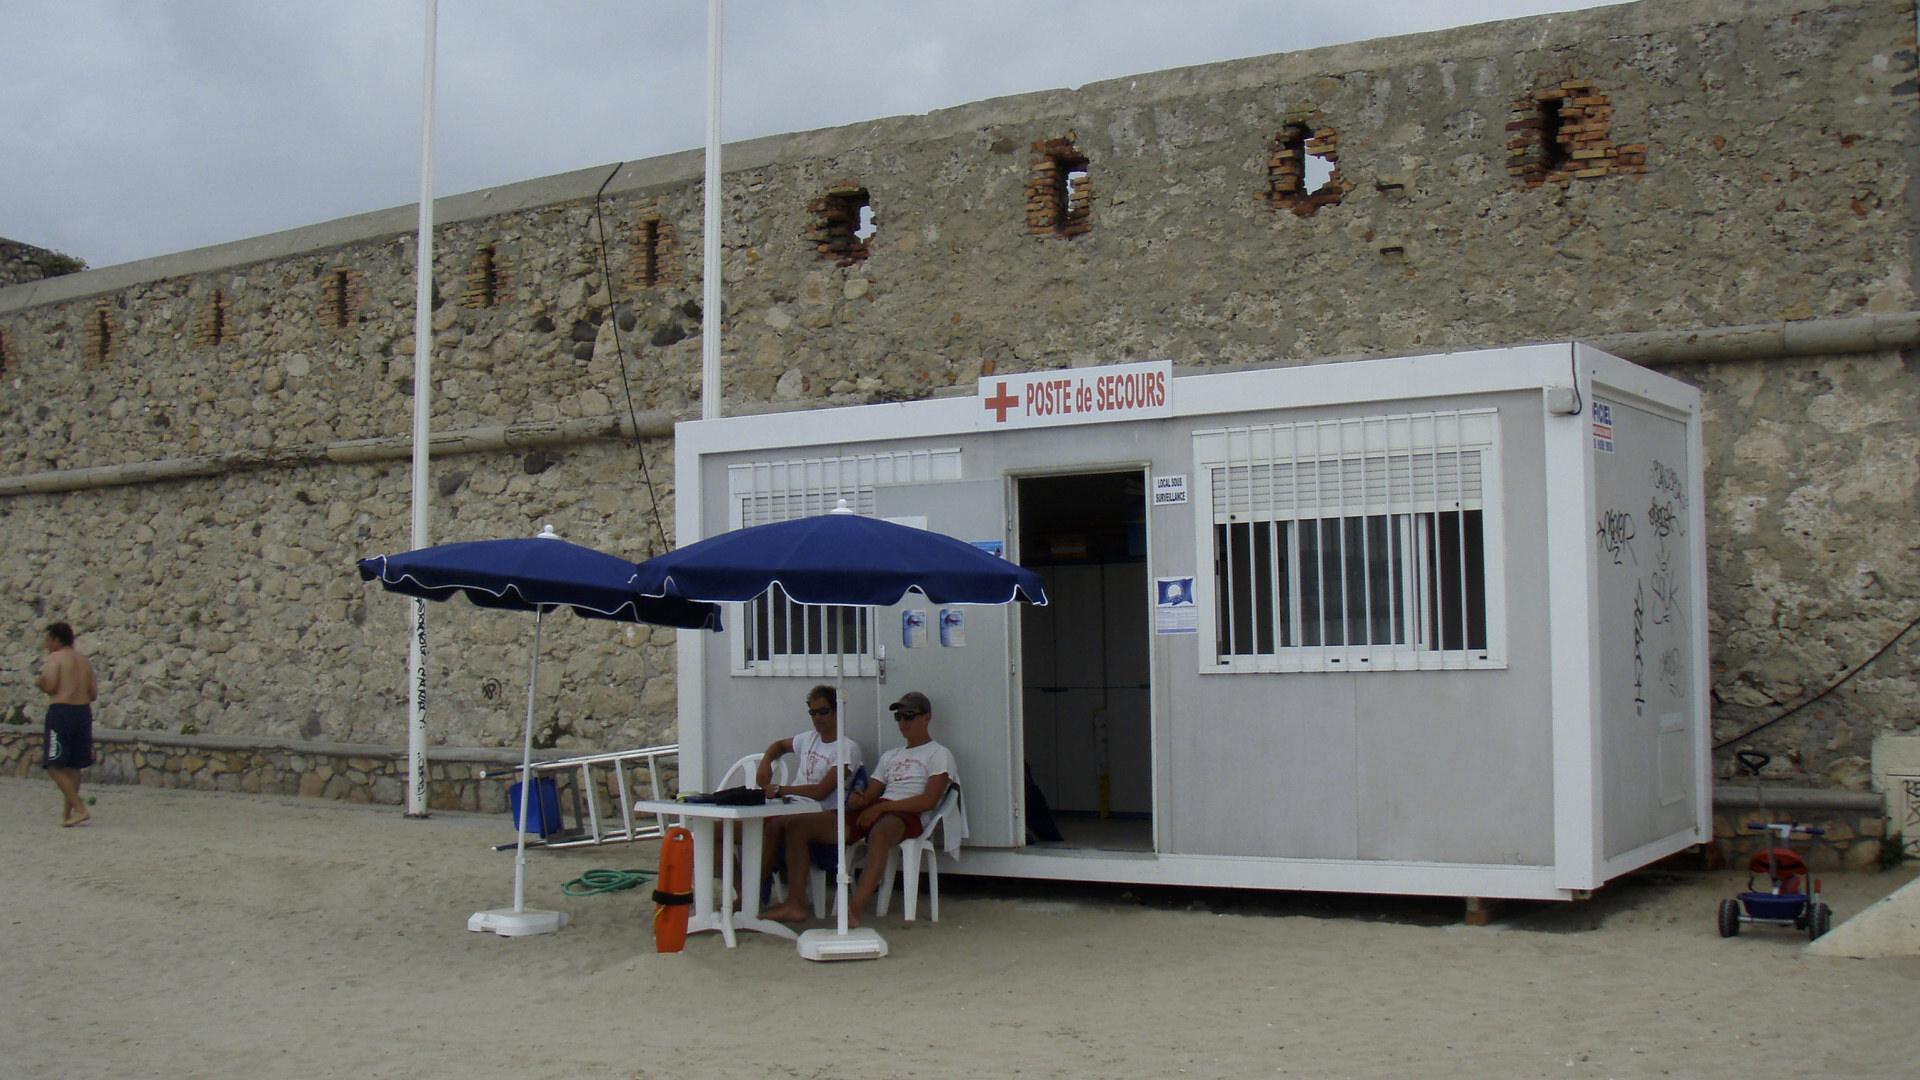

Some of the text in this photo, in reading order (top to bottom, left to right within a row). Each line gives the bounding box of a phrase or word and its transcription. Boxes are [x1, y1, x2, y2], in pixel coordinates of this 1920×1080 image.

[1026, 370, 1165, 417] POSTE de SECOURS
[1157, 477, 1183, 489] LOCAL SOUS
[1155, 491, 1186, 503] SURVEILLANCE
